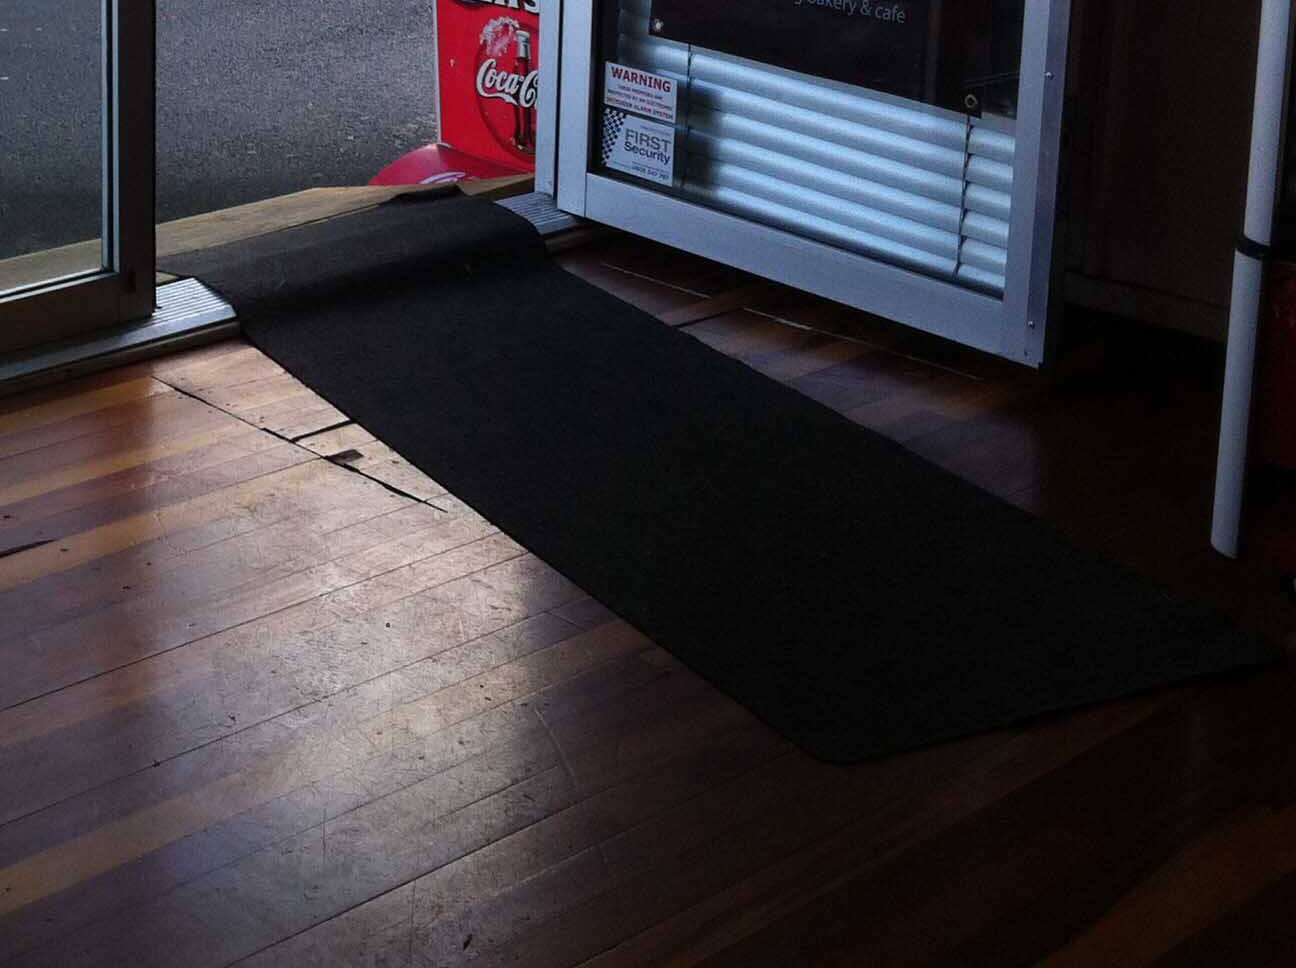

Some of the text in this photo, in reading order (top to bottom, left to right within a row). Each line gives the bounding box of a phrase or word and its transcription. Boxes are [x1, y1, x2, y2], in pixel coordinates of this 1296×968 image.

[860, 0, 873, 17] &
[875, 3, 907, 25] cafe
[611, 66, 672, 93] WARNING
[624, 128, 672, 153] FIRST
[623, 141, 671, 166] Security
